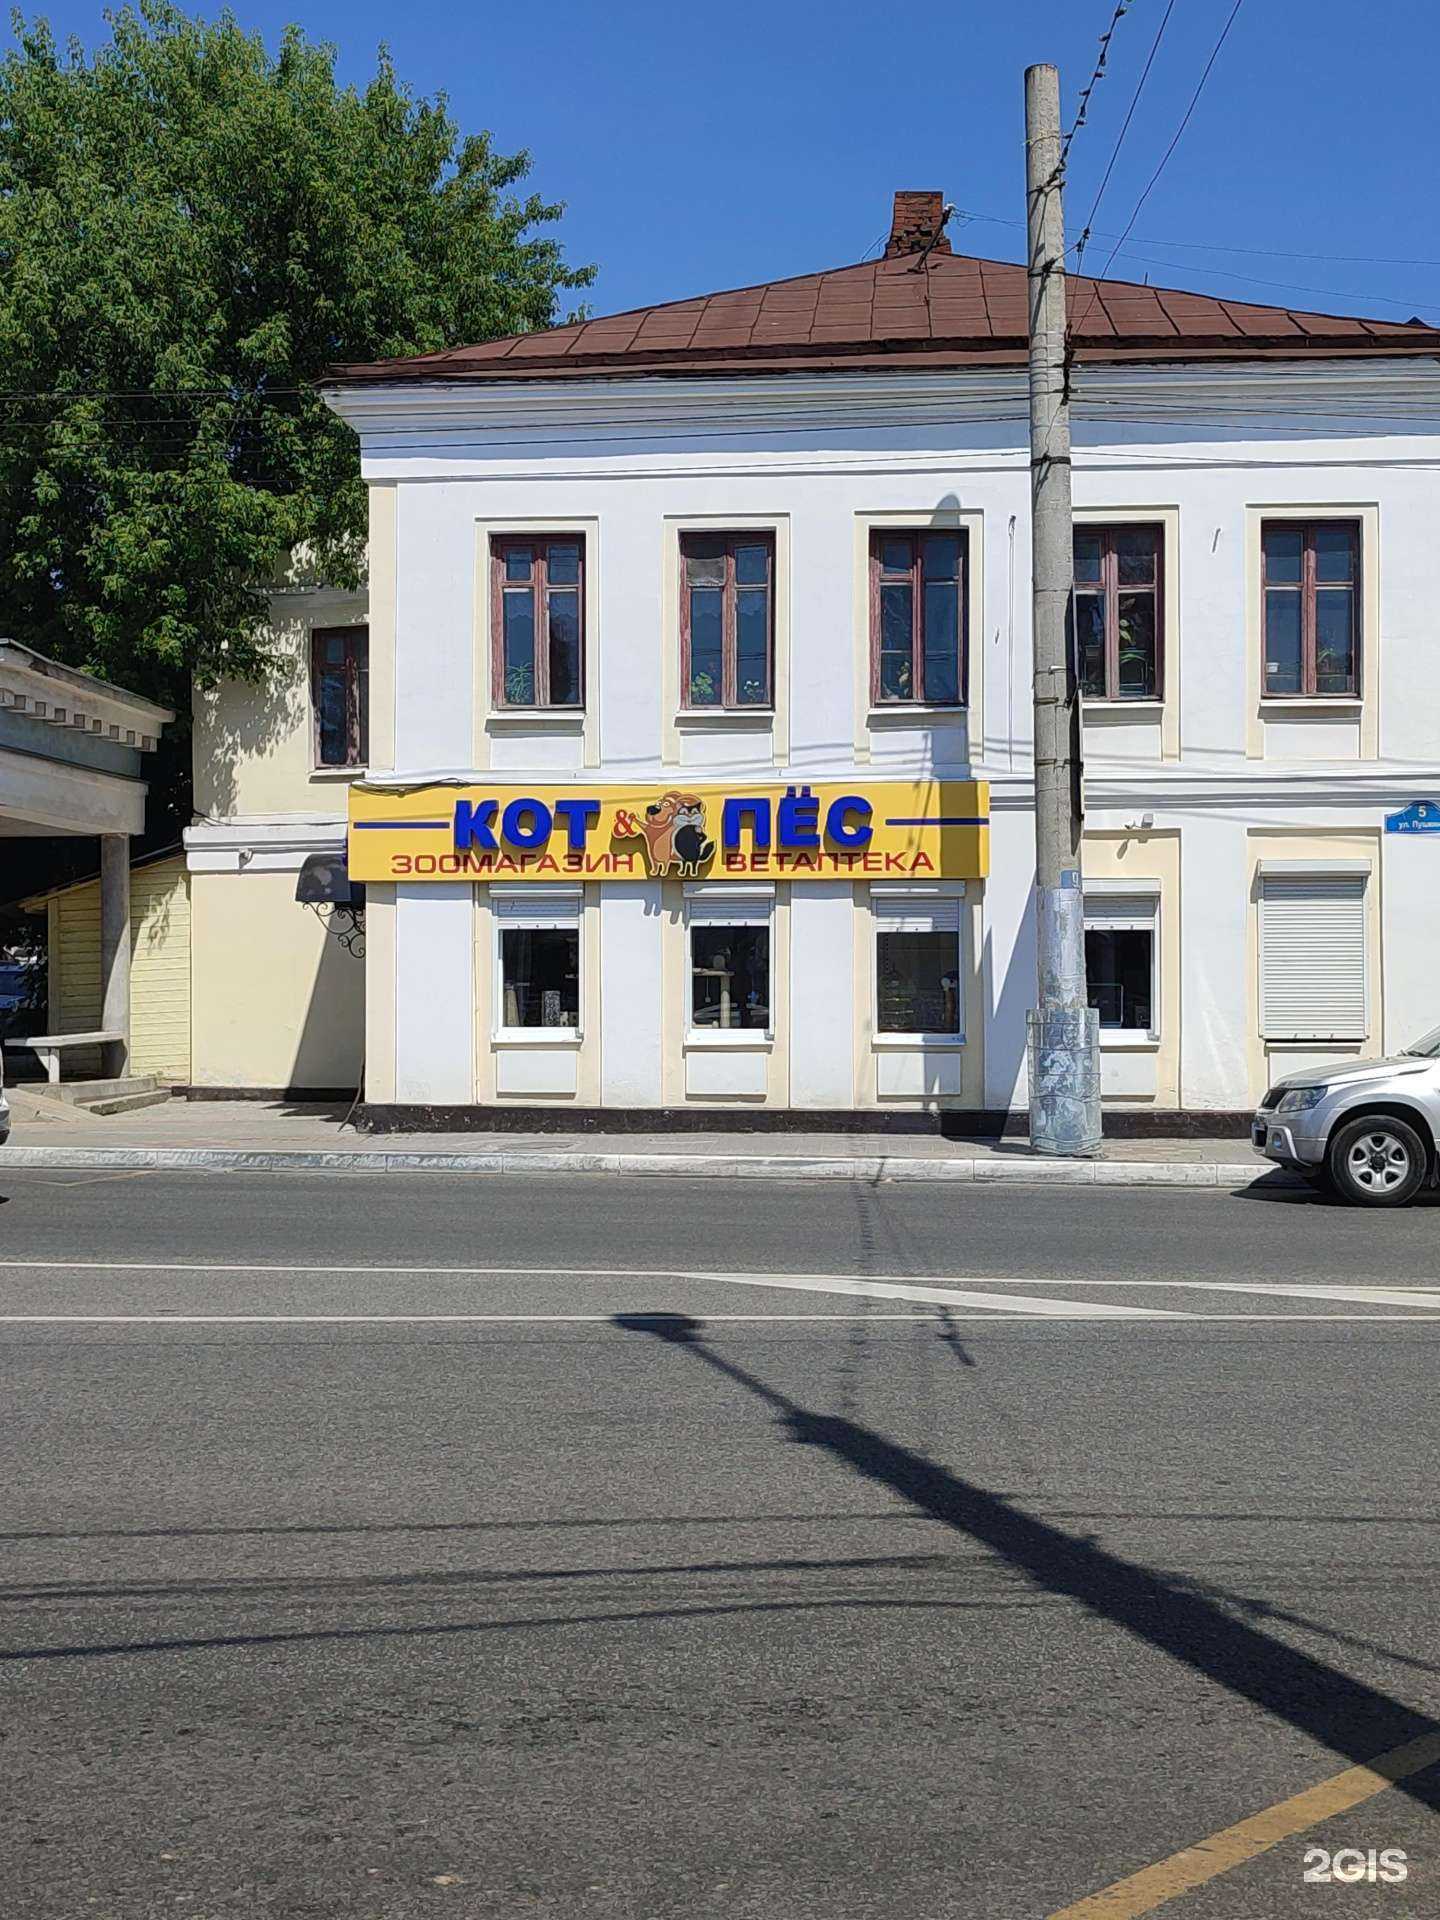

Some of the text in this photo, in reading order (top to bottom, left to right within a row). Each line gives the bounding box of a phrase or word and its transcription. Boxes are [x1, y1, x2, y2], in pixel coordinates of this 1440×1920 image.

[455, 784, 874, 849] КОТ & ПЁС
[1418, 805, 1427, 817] 5
[391, 851, 936, 874] ЗООМАГАЗИН ВЕТАПТЕКА
